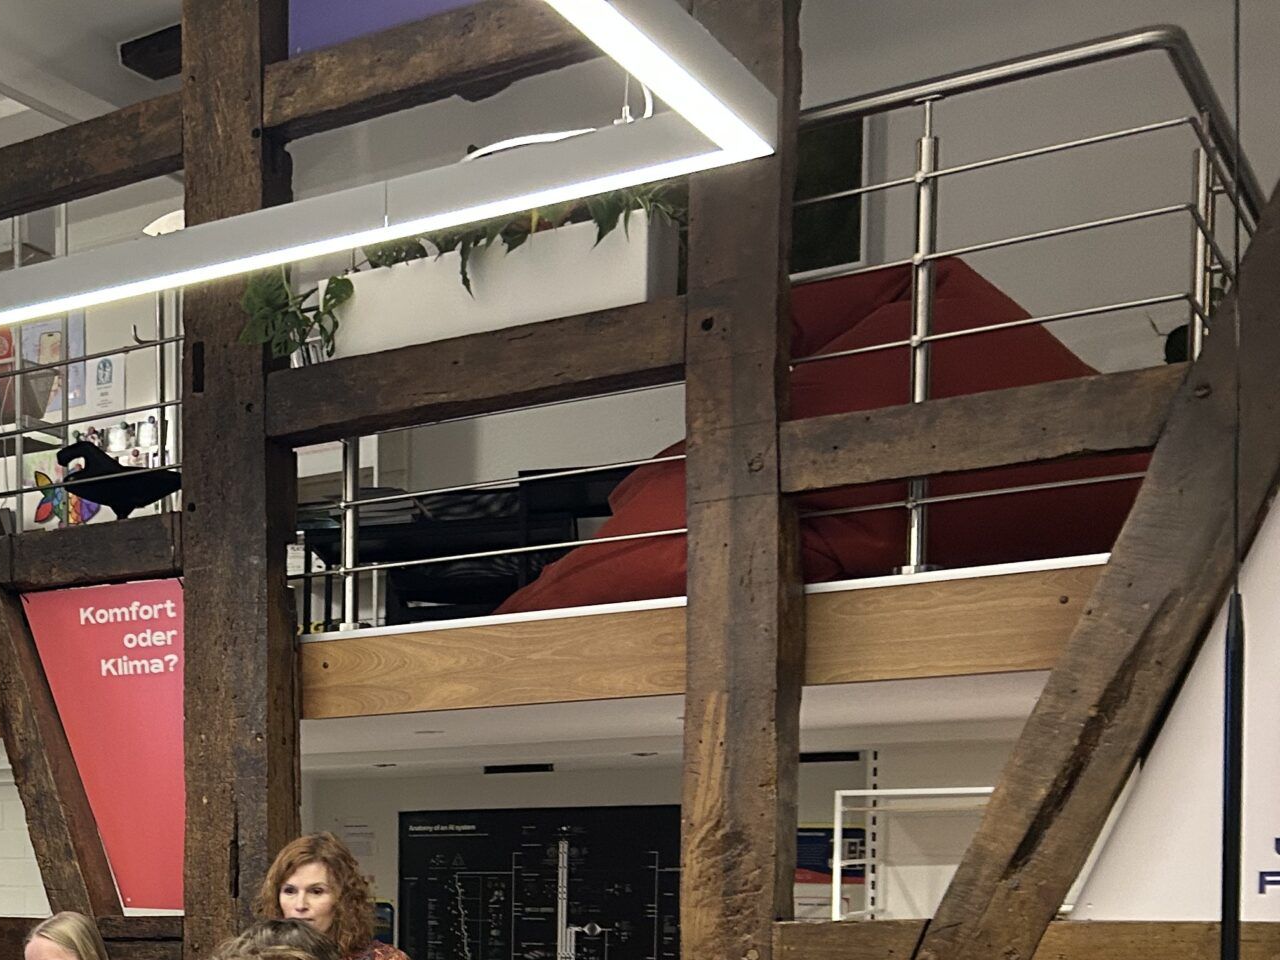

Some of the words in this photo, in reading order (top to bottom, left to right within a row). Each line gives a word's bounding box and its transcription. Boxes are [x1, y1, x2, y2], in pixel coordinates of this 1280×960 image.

[79, 599, 177, 625] Komfort
[123, 628, 178, 649] oder
[101, 653, 179, 677] Klima?
